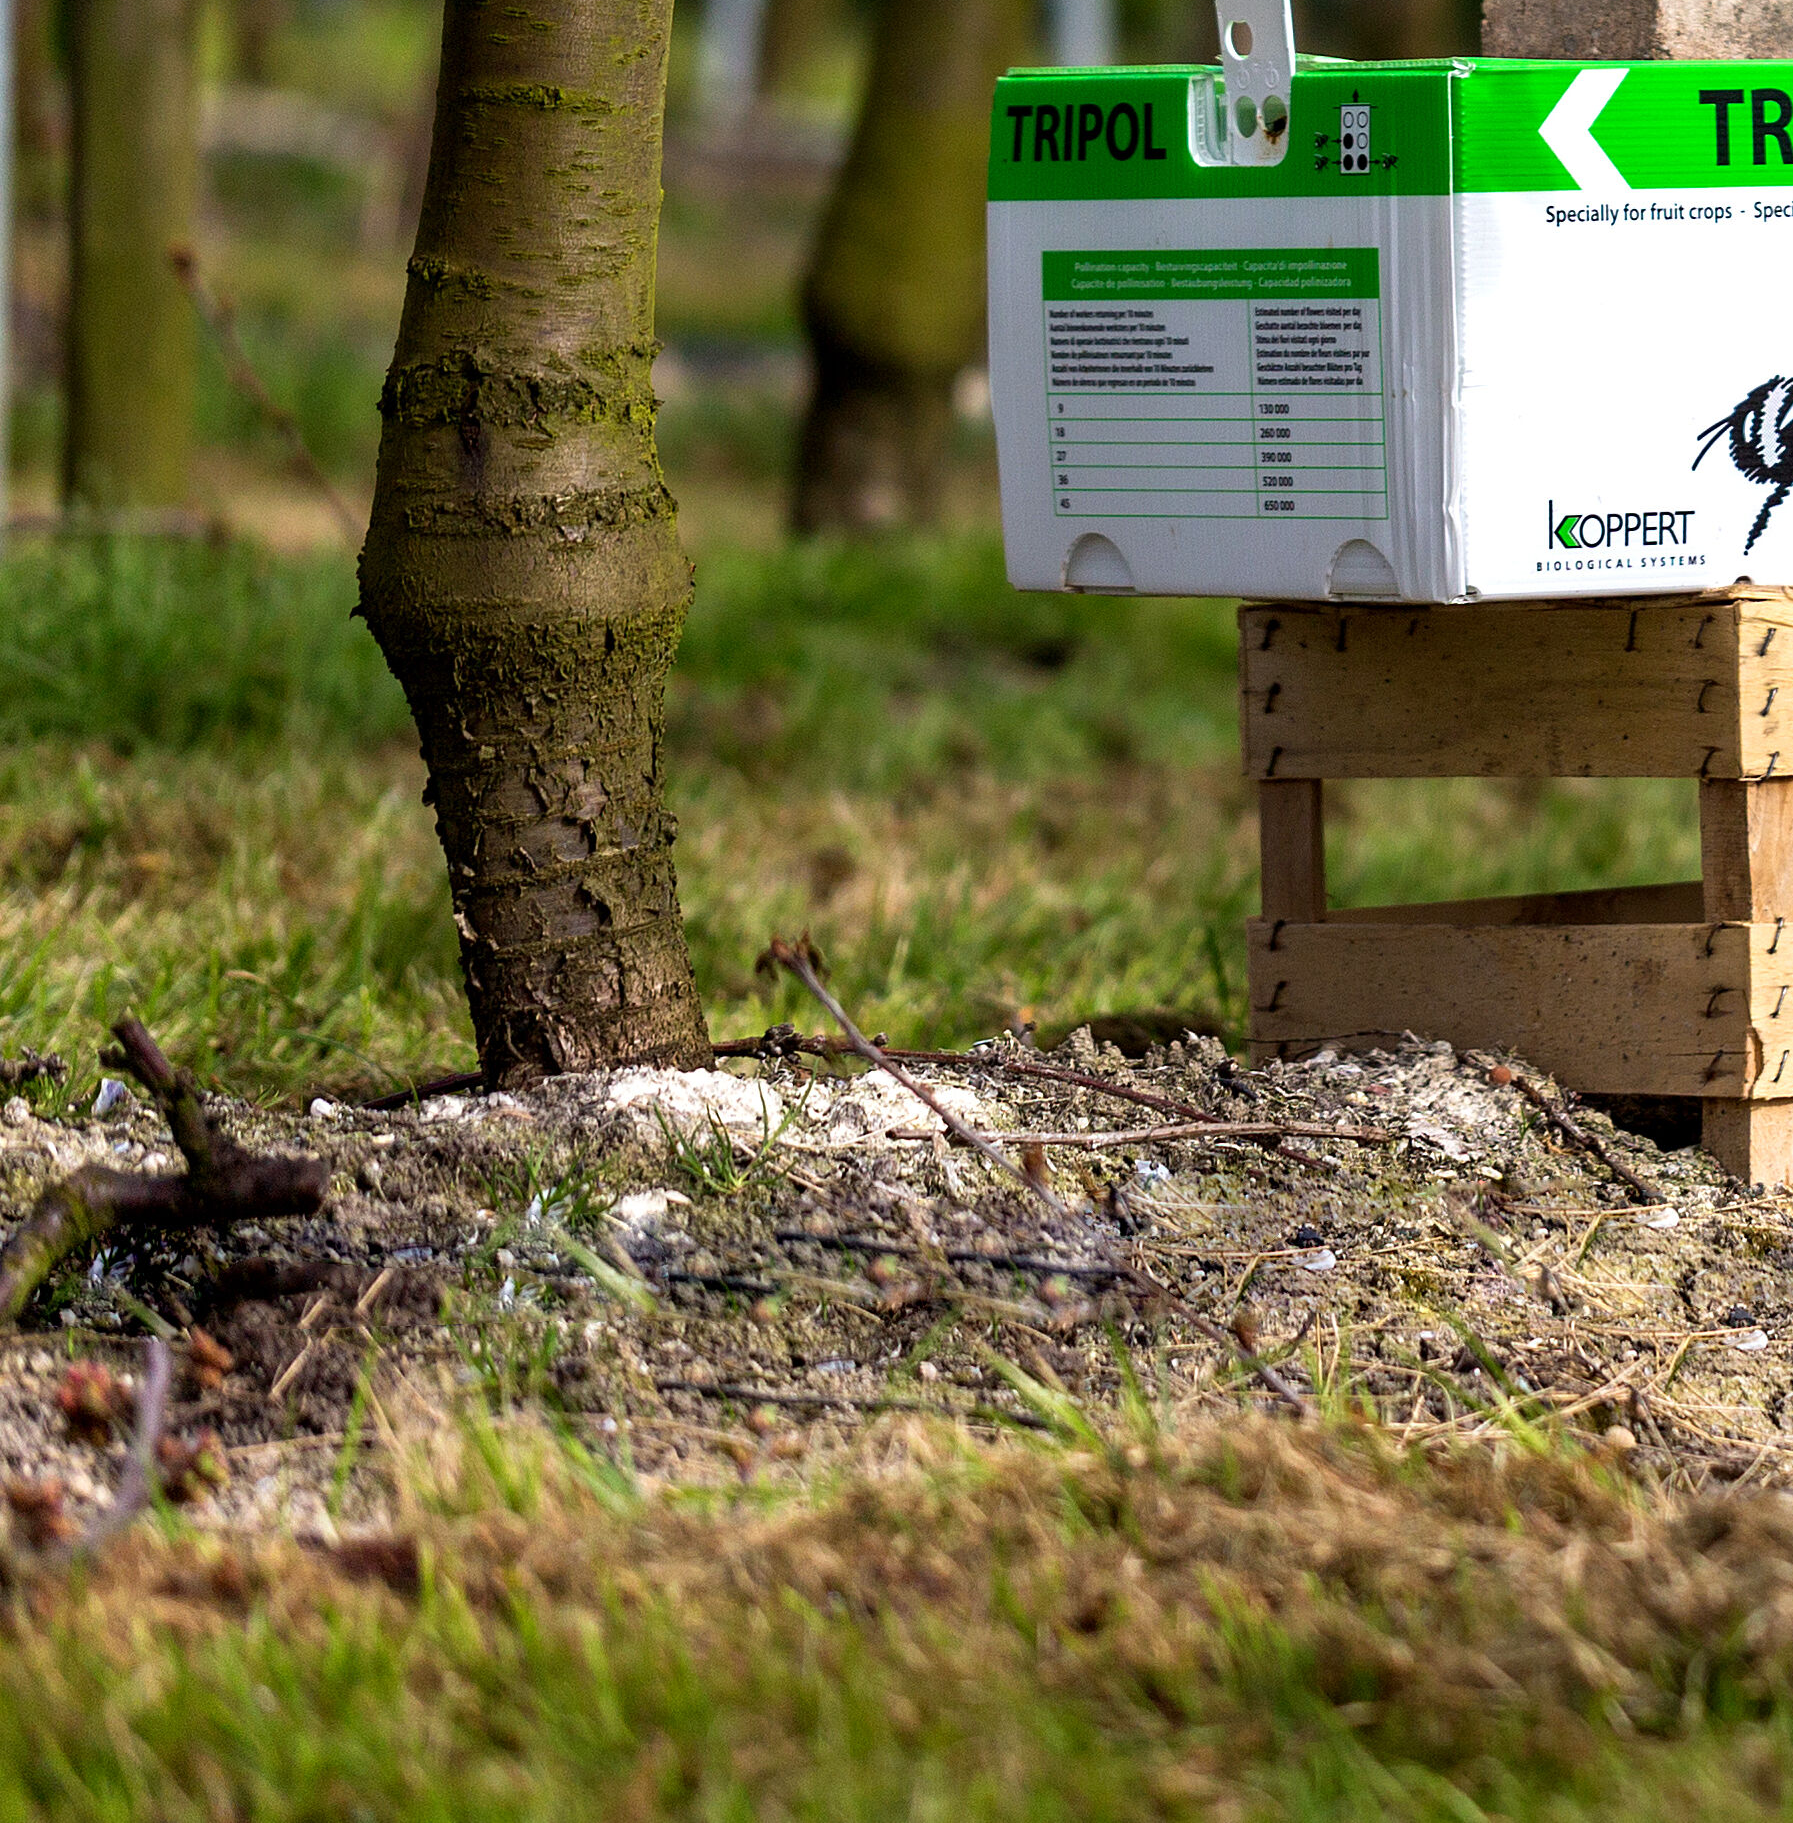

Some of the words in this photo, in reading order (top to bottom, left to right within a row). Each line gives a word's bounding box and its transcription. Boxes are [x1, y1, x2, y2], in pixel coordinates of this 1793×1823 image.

[1007, 103, 1167, 162] TRIPOL
[1545, 204, 1619, 226] Specially
[1623, 203, 1646, 220] for
[1650, 202, 1685, 220] fruit
[1688, 204, 1732, 224] crops
[1058, 403, 1064, 413] 9
[1259, 404, 1273, 414] 130
[1275, 404, 1290, 414] 000
[1260, 428, 1275, 438] 260
[1276, 428, 1291, 438] 000
[1056, 450, 1067, 462] 27
[1261, 452, 1276, 463] 390
[1277, 452, 1292, 463] 000
[1262, 476, 1277, 487] 520
[1278, 476, 1294, 487] 000
[1264, 500, 1279, 511] 650
[1280, 500, 1295, 511] 000
[1536, 558, 1633, 572] BIOLOGICAL
[1641, 554, 1706, 568] SYSTEMS
